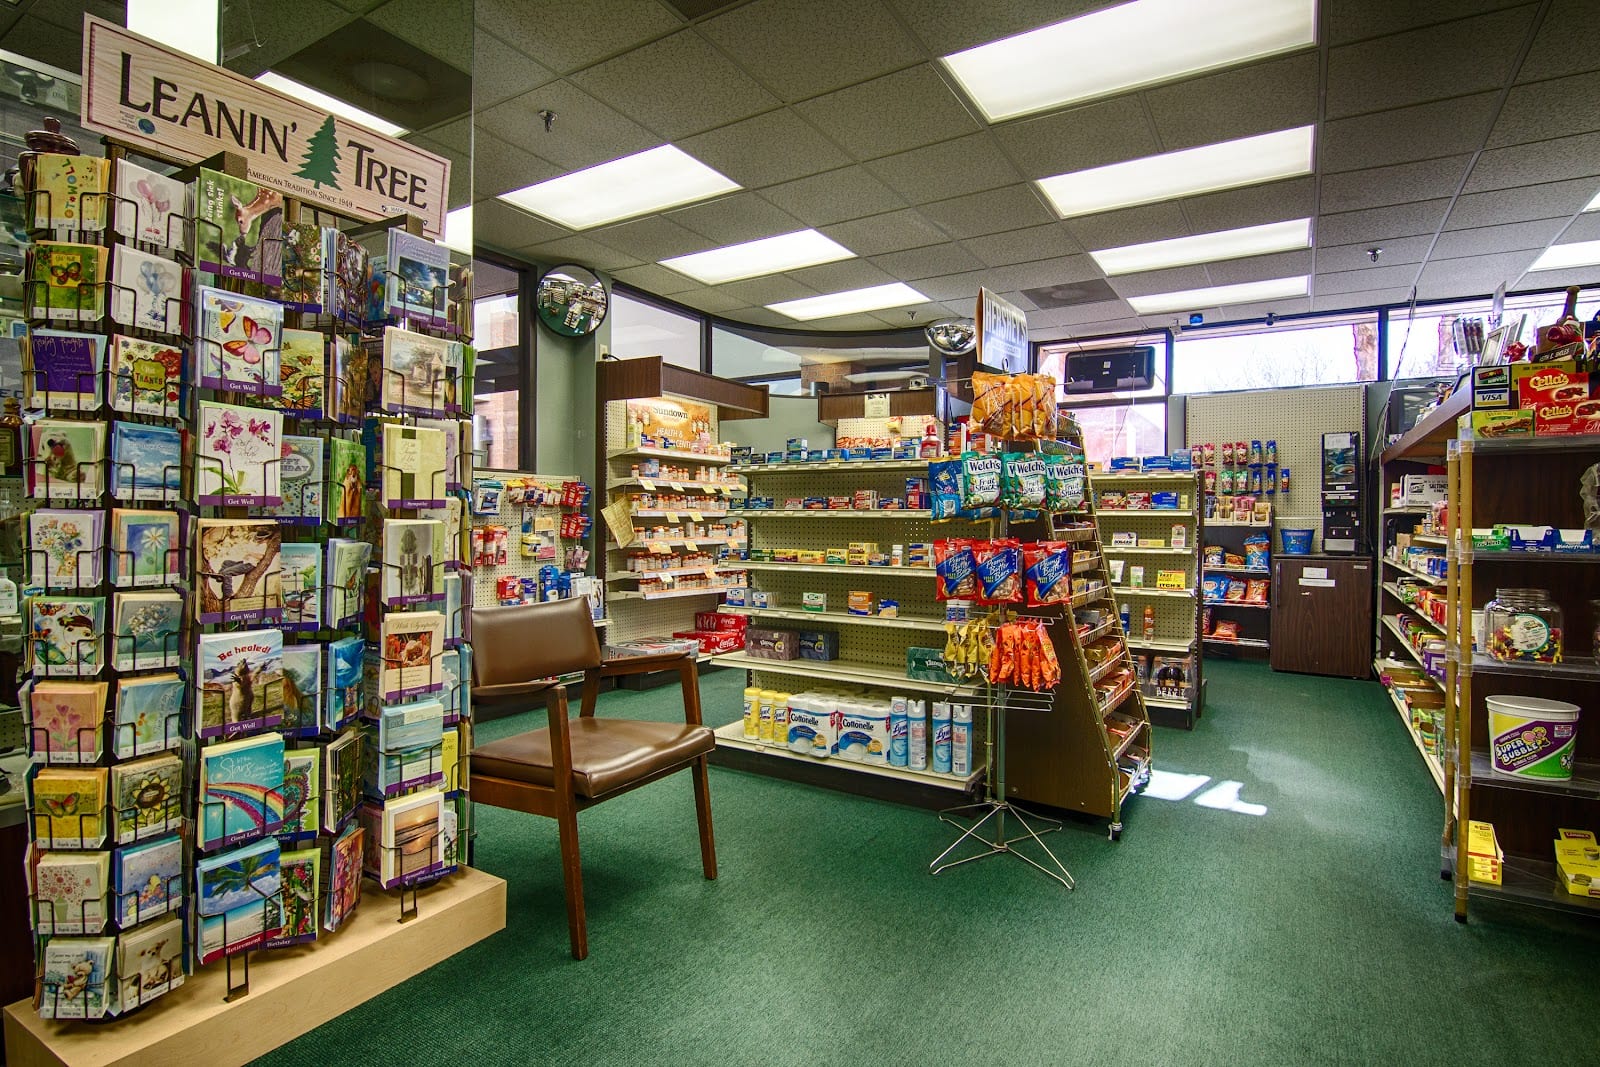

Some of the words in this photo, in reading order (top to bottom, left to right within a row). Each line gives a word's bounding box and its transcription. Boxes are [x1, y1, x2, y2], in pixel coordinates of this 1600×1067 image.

[119, 51, 297, 163] LEANIN'
[347, 140, 428, 210] TREE
[206, 180, 215, 197] sick
[247, 168, 283, 187] AMERICAN
[284, 180, 318, 198] TRADITION
[338, 197, 353, 210] 1949
[216, 187, 226, 219] stinks!
[229, 269, 241, 277] Get
[242, 272, 256, 280] Well
[985, 296, 1028, 346] HERSHEY'S
[242, 384, 257, 392] Well
[1529, 374, 1569, 391] Cella's
[1481, 393, 1503, 401] VISA
[652, 406, 688, 419] Sundown
[1539, 406, 1573, 420] Cella's
[656, 427, 678, 437] HEALTH
[1538, 424, 1550, 432] 72
[968, 459, 1002, 473] Welch's
[1016, 461, 1046, 474] Welch's
[1055, 464, 1085, 477] Welch's
[948, 554, 969, 566] Peanut
[951, 560, 971, 573] Butter
[986, 555, 1007, 569] Peanut
[1039, 556, 1061, 570] Peanut
[989, 563, 1009, 575] Butter
[1043, 563, 1064, 576] Butter
[217, 651, 233, 662] Be
[234, 643, 272, 656] healed!
[790, 713, 819, 727] Cottonelle
[842, 718, 874, 732] Cottonelle
[1495, 739, 1524, 758] SUPER
[1501, 742, 1539, 763] BUBBLE
[220, 757, 255, 779] Stars
[230, 834, 246, 842] Good
[247, 830, 261, 839] Luck
[225, 937, 262, 955] Retirement
[266, 939, 291, 948] Birthday
